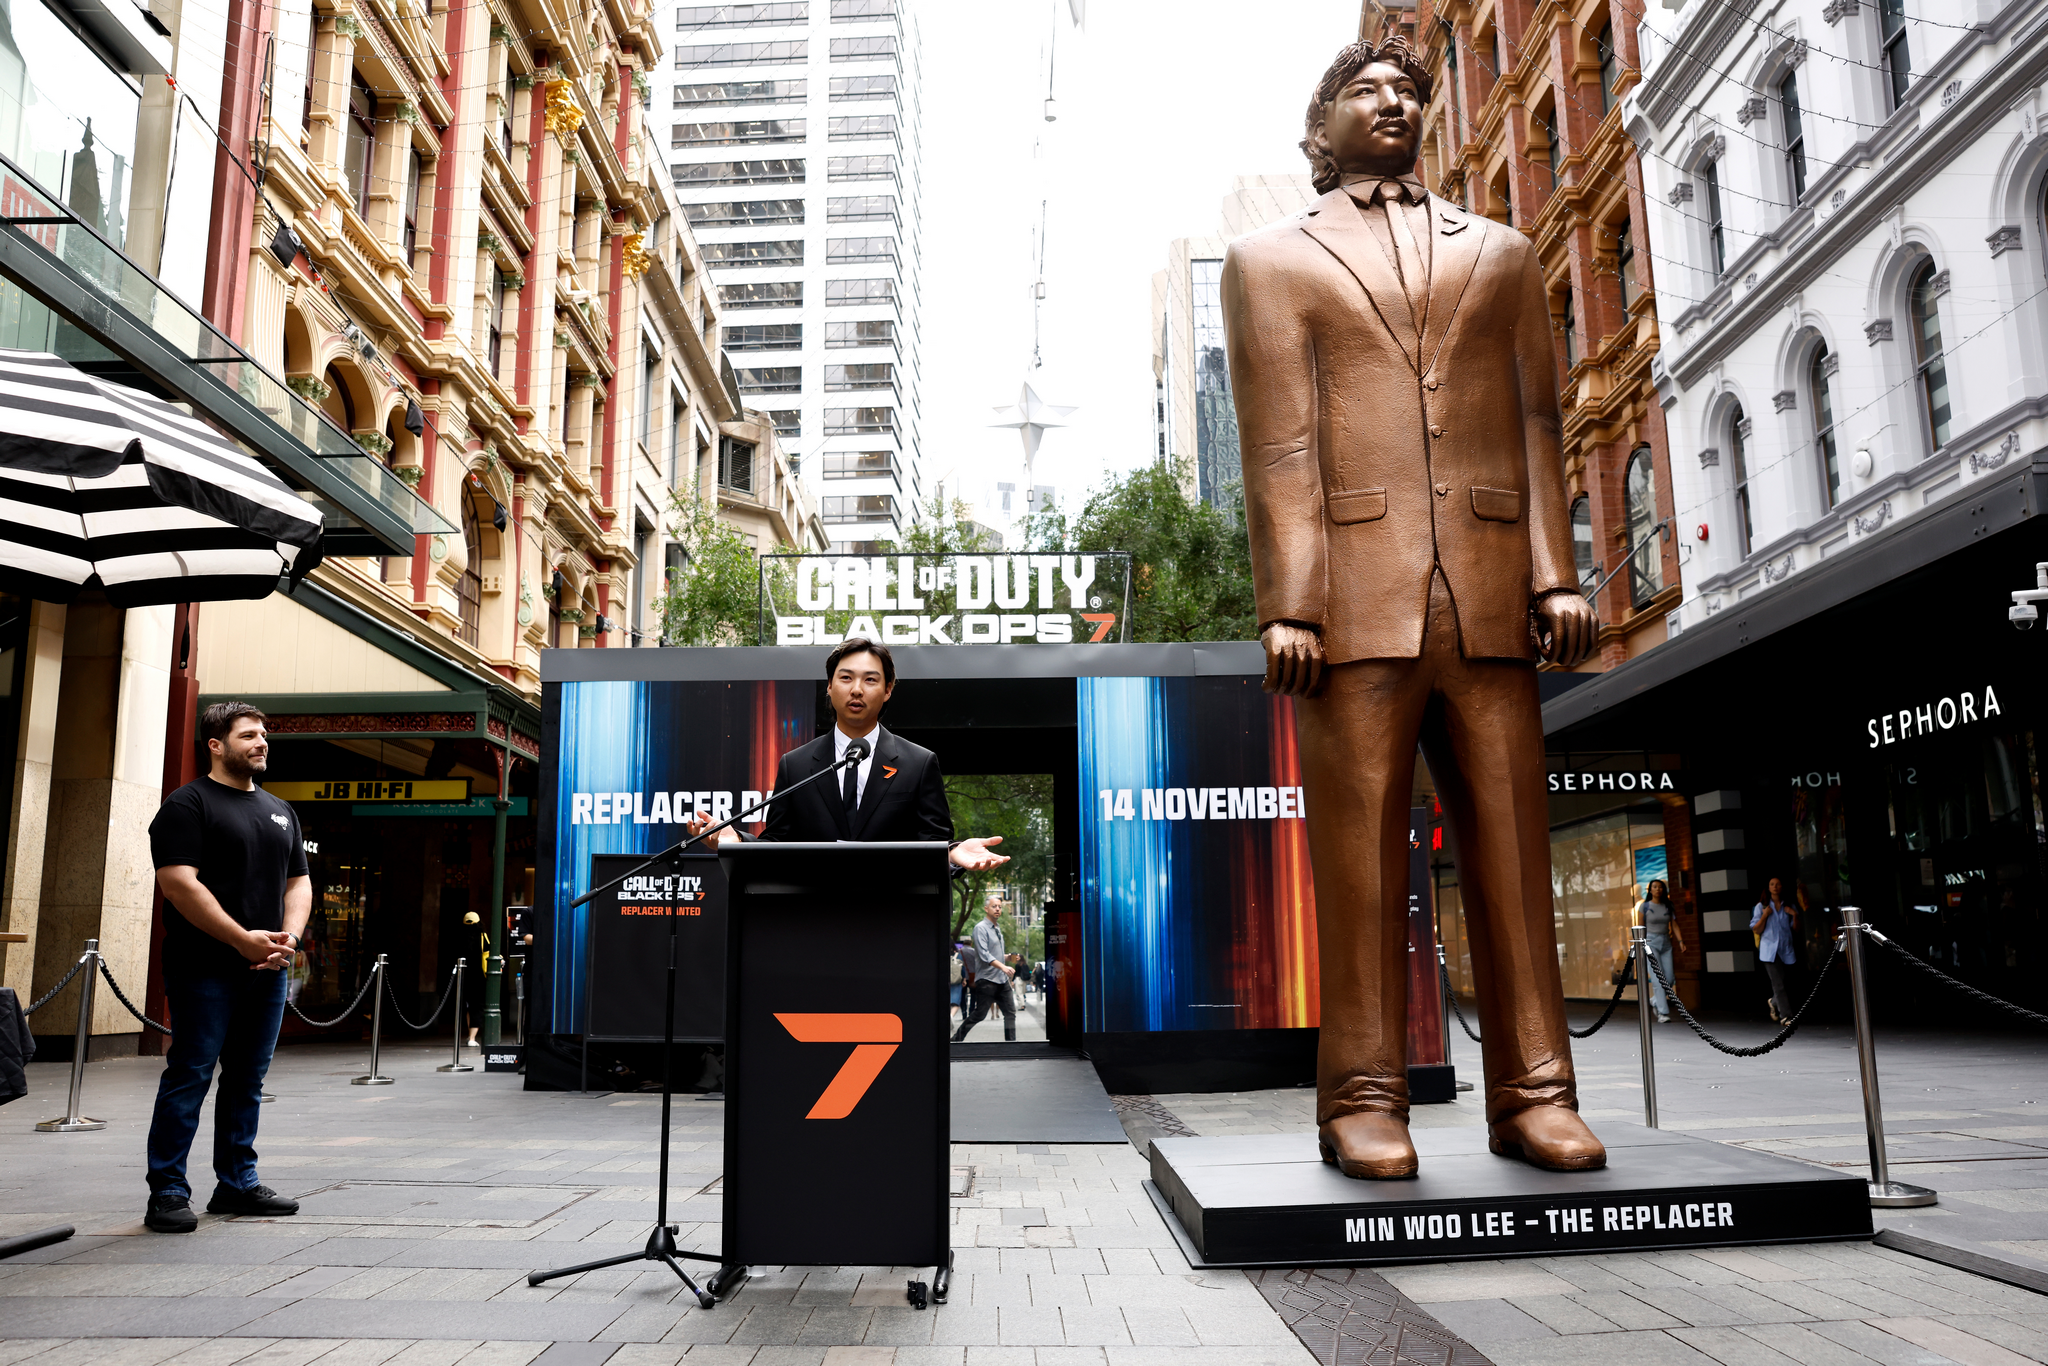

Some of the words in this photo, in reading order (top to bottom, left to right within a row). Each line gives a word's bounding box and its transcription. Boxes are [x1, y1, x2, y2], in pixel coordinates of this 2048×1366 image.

[797, 556, 924, 611] CALL
[919, 566, 951, 590] OF
[776, 615, 955, 646] BLACK
[962, 614, 1073, 643] OPS
[1081, 613, 1116, 642] 7
[1867, 685, 2001, 748] SEPHORA
[882, 765, 898, 779] 7
[1548, 772, 1674, 791] SEPHORA
[314, 782, 350, 799] JB
[1100, 789, 1135, 821] 14
[1142, 786, 1306, 820] NOVEMBE
[572, 791, 733, 824] REPLACER
[617, 891, 664, 900] BLACK
[695, 892, 706, 900] 7
[623, 876, 656, 891] CALL
[621, 906, 664, 916] REPLACER
[773, 1013, 903, 1119] 7
[1345, 1217, 1395, 1243] MIN
[1404, 1214, 1462, 1241] WOO
[1471, 1211, 1515, 1238] LEE
[1545, 1207, 1594, 1234] THE
[1603, 1202, 1734, 1232] REPLACER
